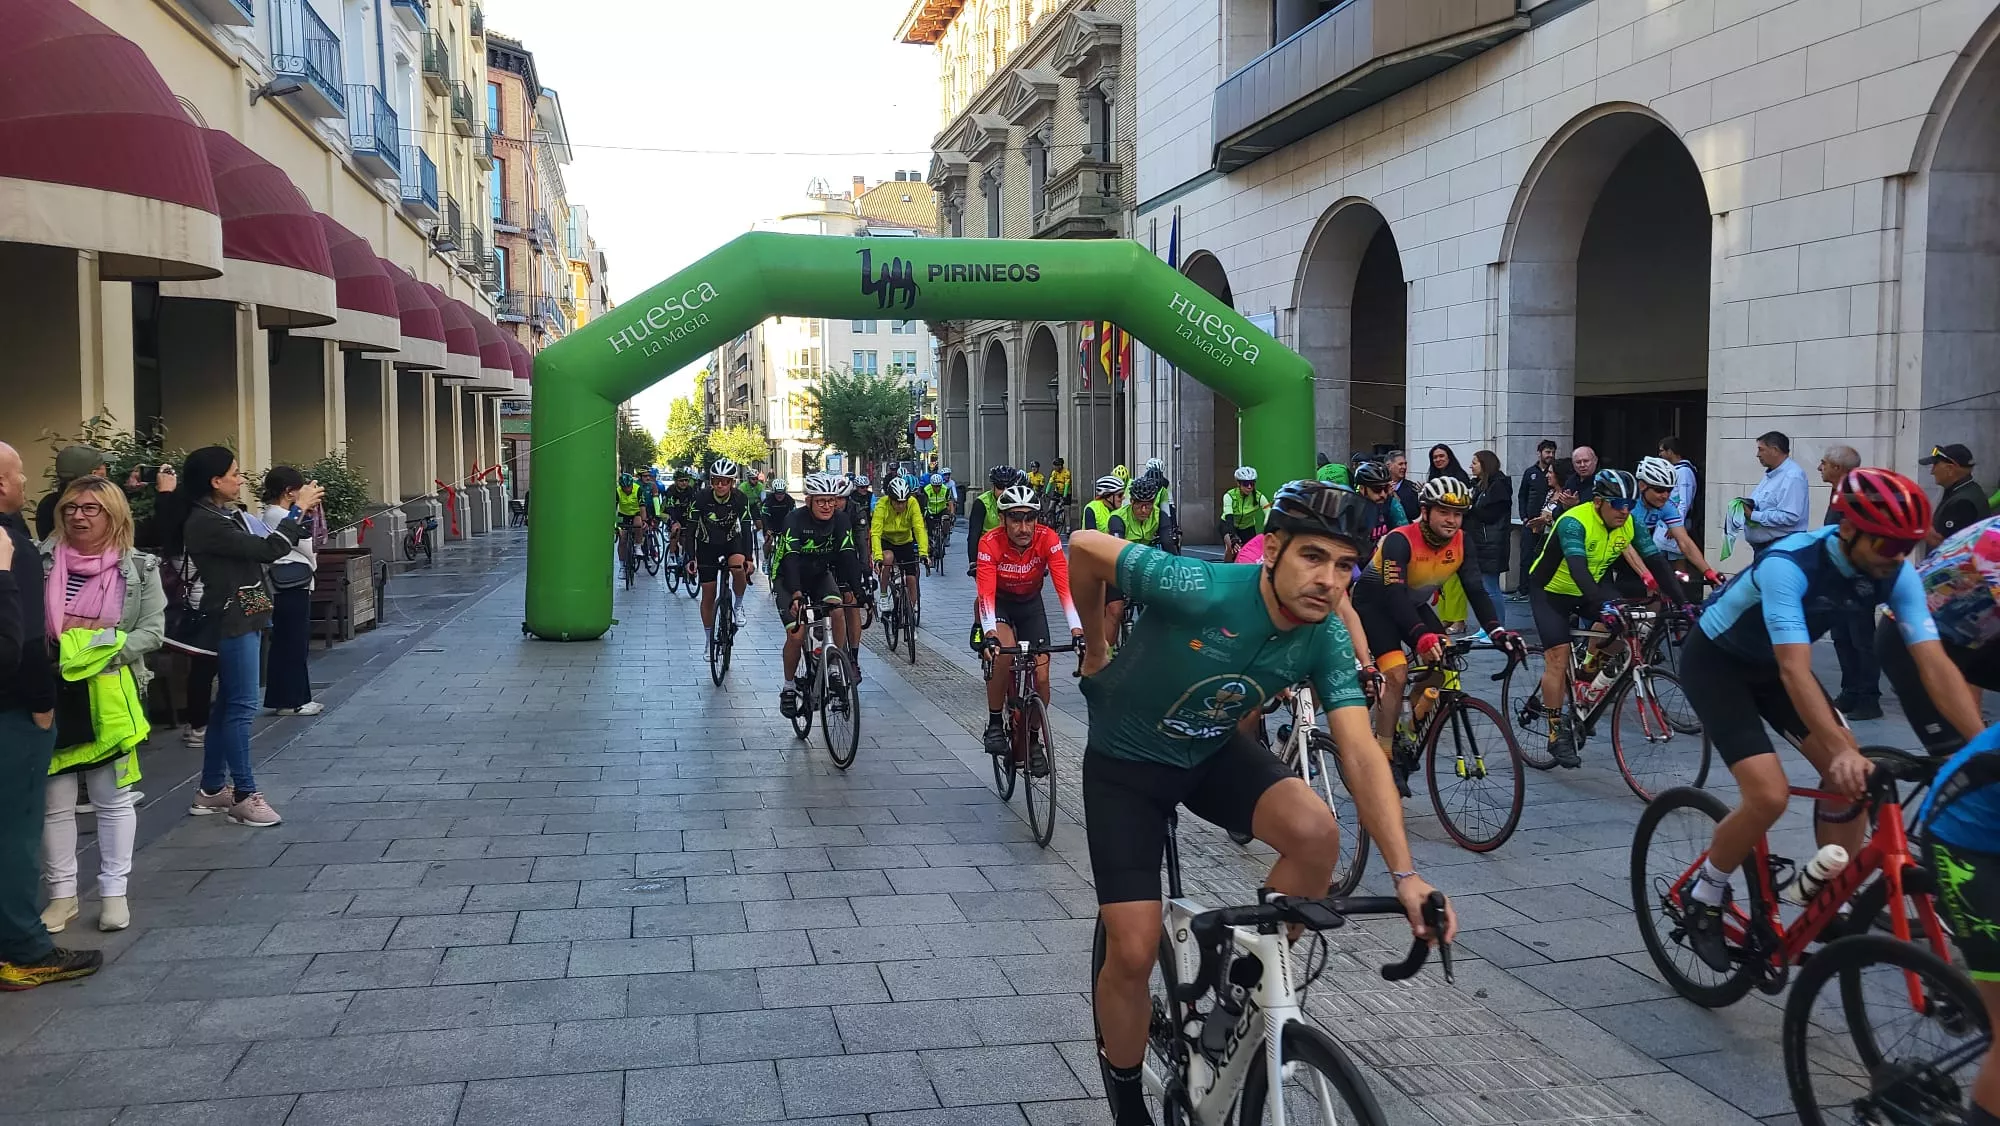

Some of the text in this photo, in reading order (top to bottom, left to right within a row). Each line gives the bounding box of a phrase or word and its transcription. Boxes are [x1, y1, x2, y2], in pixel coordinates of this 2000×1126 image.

[928, 263, 1041, 283] PIRINEOS
[1175, 323, 1193, 340] La
[642, 340, 663, 358] La
